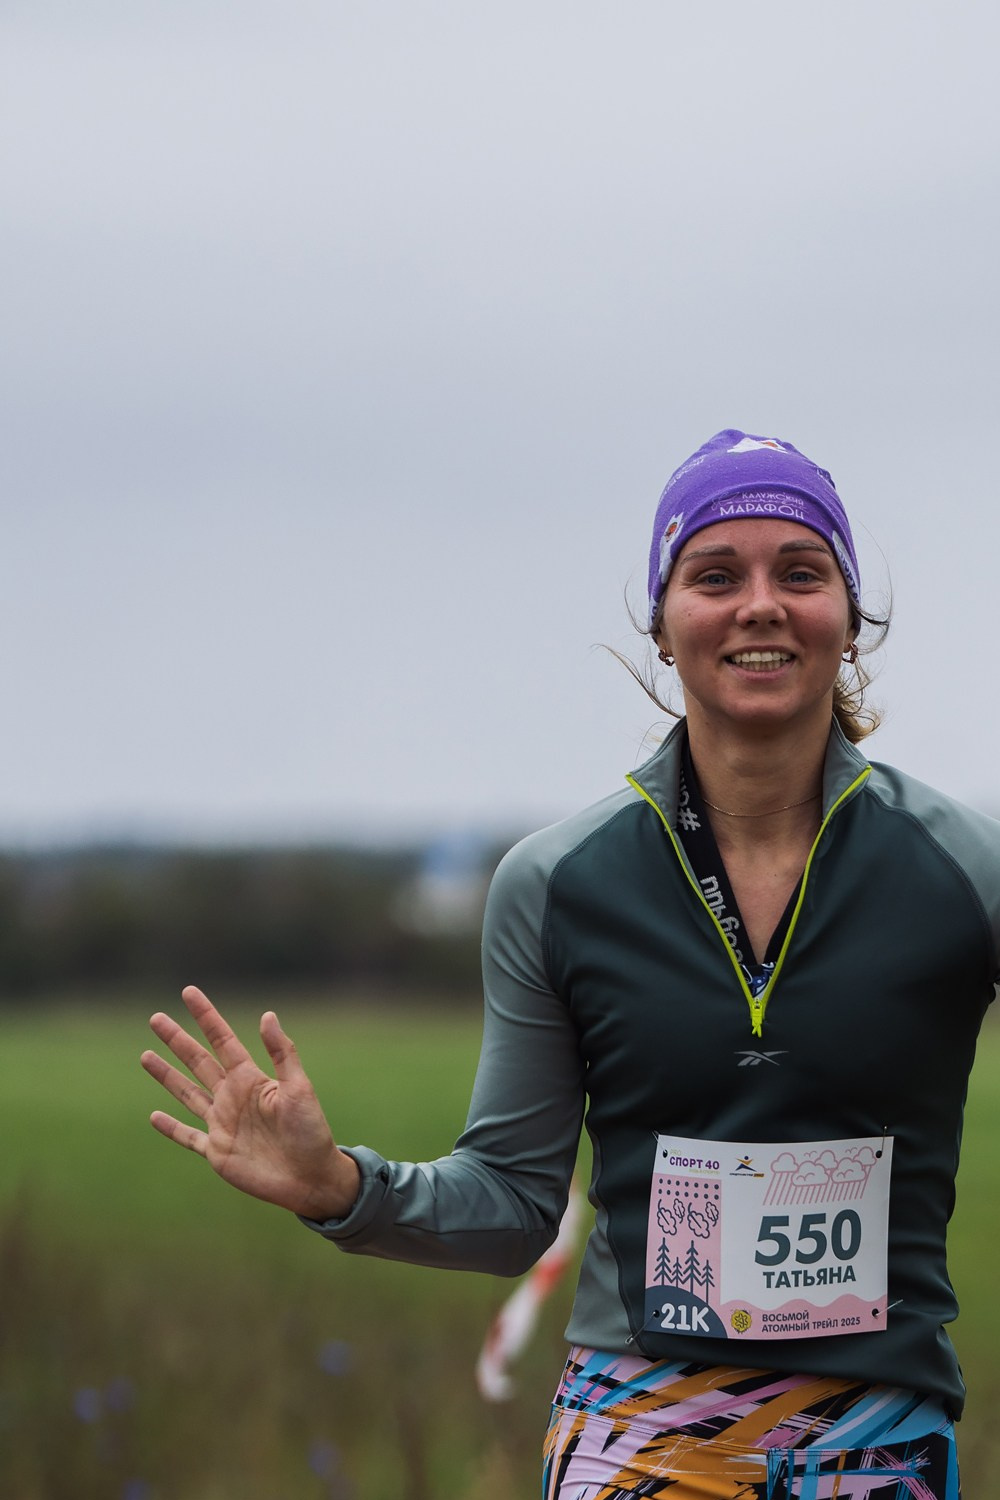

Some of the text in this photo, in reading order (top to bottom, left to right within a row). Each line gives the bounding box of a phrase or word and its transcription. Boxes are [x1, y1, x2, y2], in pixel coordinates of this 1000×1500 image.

[669, 1156, 720, 1170] СПОРТ 40
[754, 1208, 862, 1266] 550
[763, 1265, 857, 1289] ТАТЬЯНА
[762, 1310, 809, 1322] ВОСЬМОЙ
[762, 1316, 861, 1333] АТОМНЫЙ ТРЕЙЛ 2025
